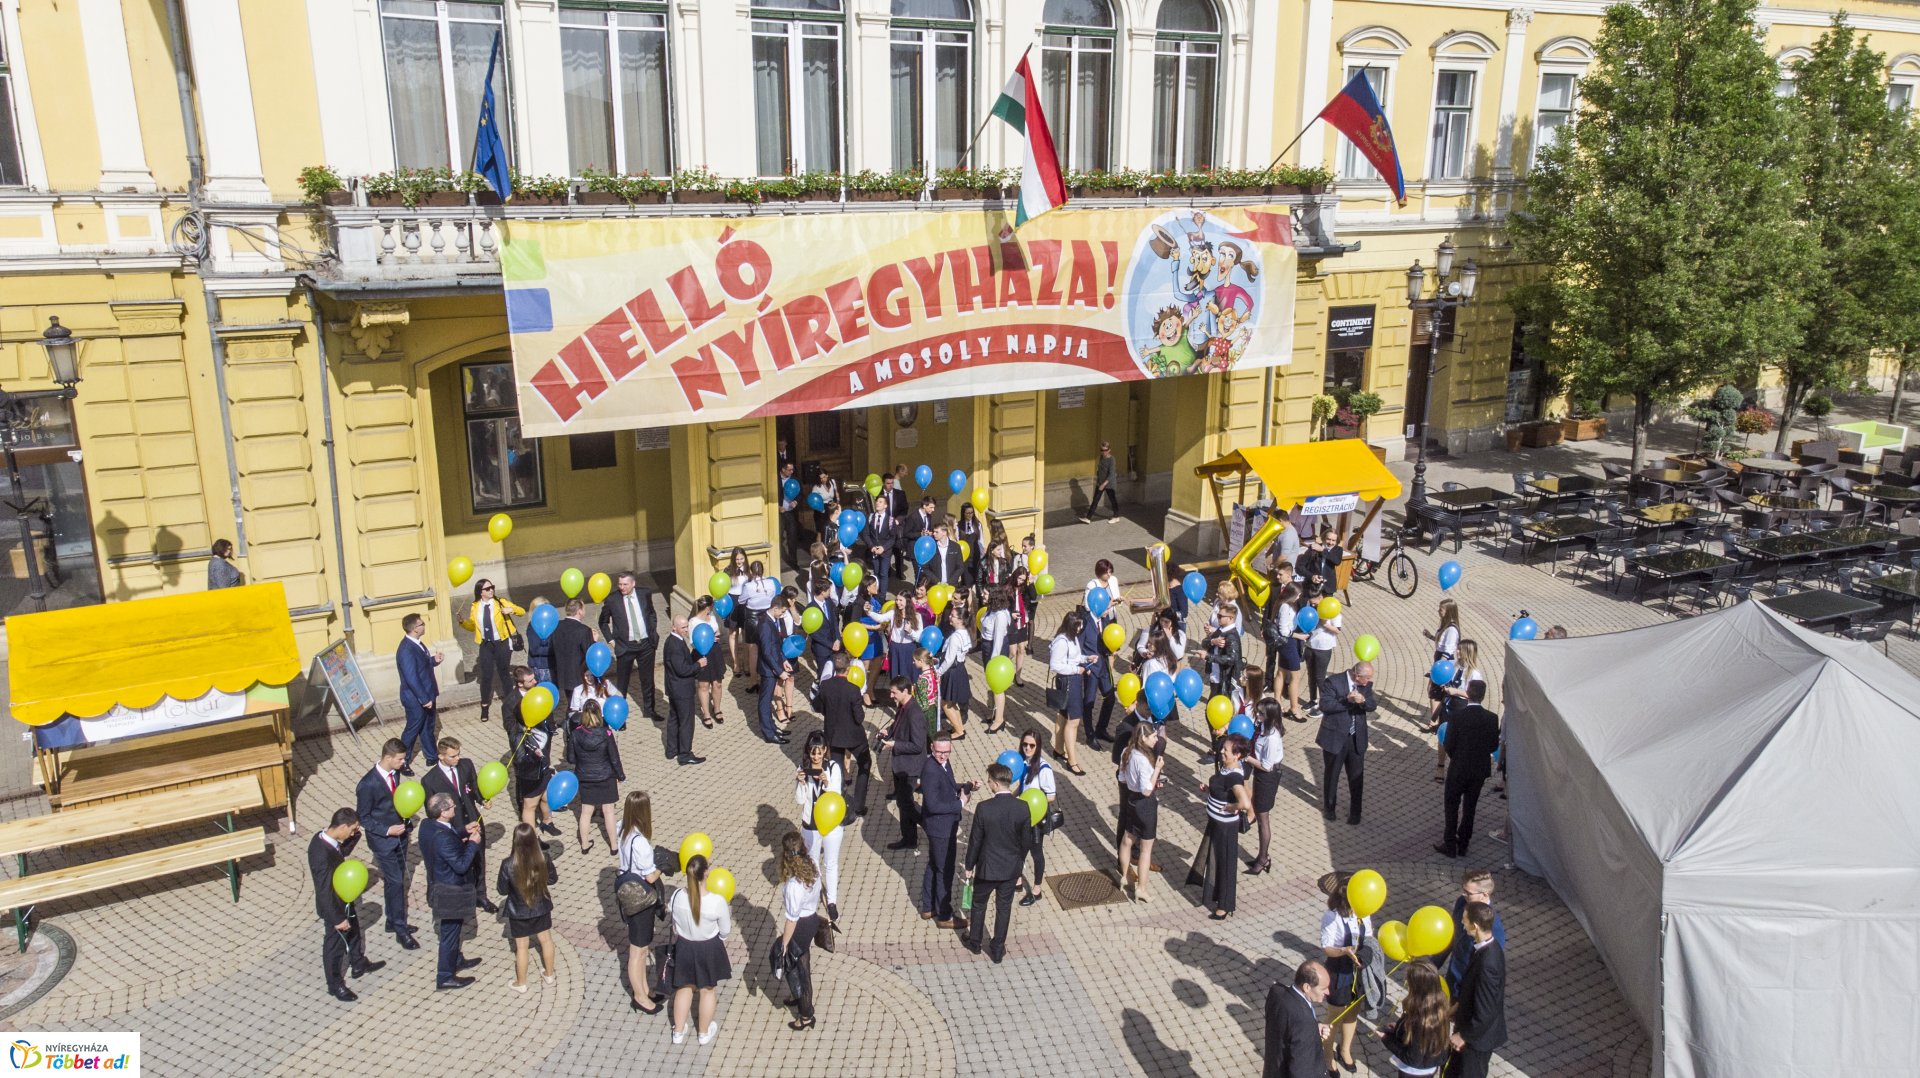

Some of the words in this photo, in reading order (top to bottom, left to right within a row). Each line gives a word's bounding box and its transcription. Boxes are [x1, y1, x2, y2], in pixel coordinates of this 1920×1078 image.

[530, 225, 773, 426] HELLÓ
[670, 225, 1119, 415] NYÍREGYHÁZA!
[1330, 317, 1372, 328] CONTINENT
[849, 370, 864, 394] A
[874, 336, 991, 383] MOSOLY
[1006, 334, 1088, 359] NAPJA
[1304, 502, 1355, 514] REGISZTRÁCIÓ
